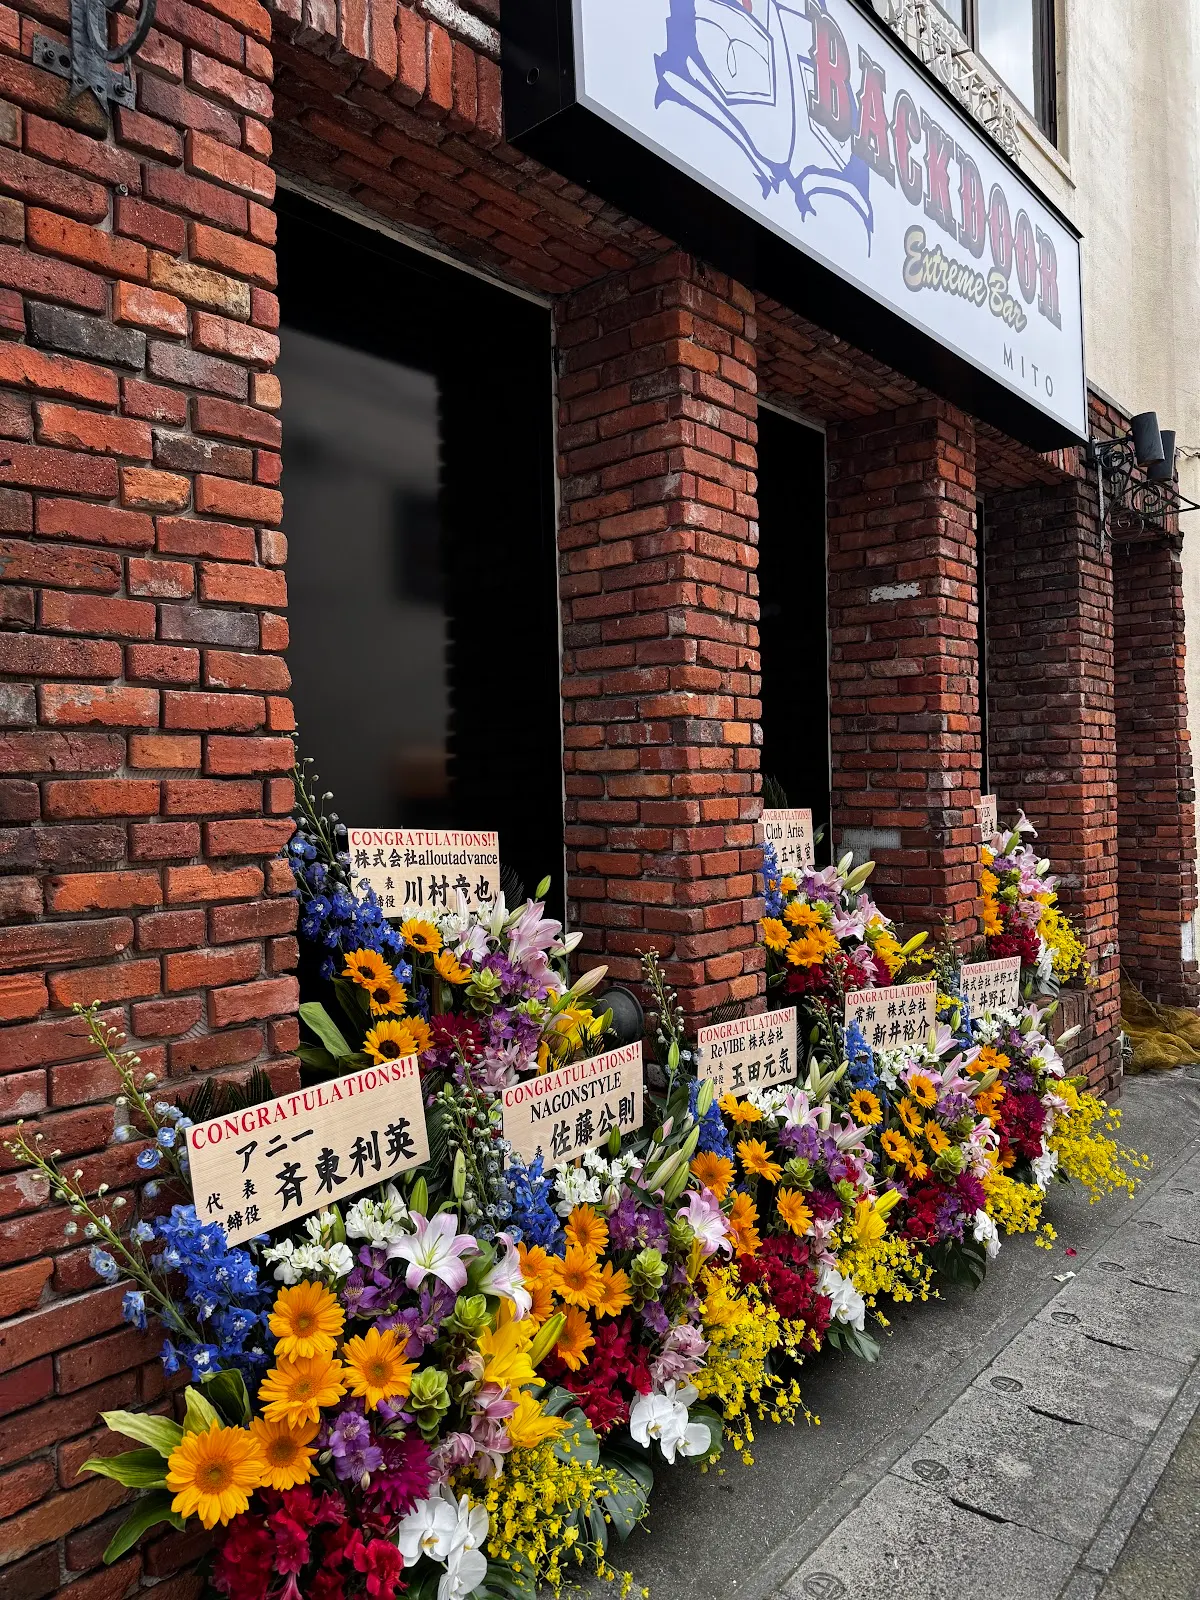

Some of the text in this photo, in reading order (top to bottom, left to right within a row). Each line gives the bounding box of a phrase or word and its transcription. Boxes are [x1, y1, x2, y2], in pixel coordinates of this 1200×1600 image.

[808, 2, 1062, 332] BACKDOOR
[903, 225, 1028, 333] Extreme Bar
[1003, 342, 1054, 398] MITO
[351, 831, 496, 847] CONGRATULATIONS!!
[765, 822, 805, 840] Club Aries
[354, 848, 498, 869] 株式会社alloutadvance
[847, 982, 935, 1006] CONGRATULATIONS!!
[887, 997, 927, 1018] 株式会社
[700, 1007, 795, 1044] CONGRATULATIONS!!
[710, 1026, 784, 1059] ReVIBE 株式会社
[872, 1015, 930, 1047] 新井裕介
[505, 1043, 640, 1108] CONGRATULATIONS!!
[729, 1047, 792, 1091] 玉田元気
[192, 1056, 415, 1150] CONGRATULATIONS!!
[530, 1071, 622, 1124] NAGONSTYLE
[550, 1091, 635, 1160] 佐藤公則
[235, 1129, 315, 1174] アニー
